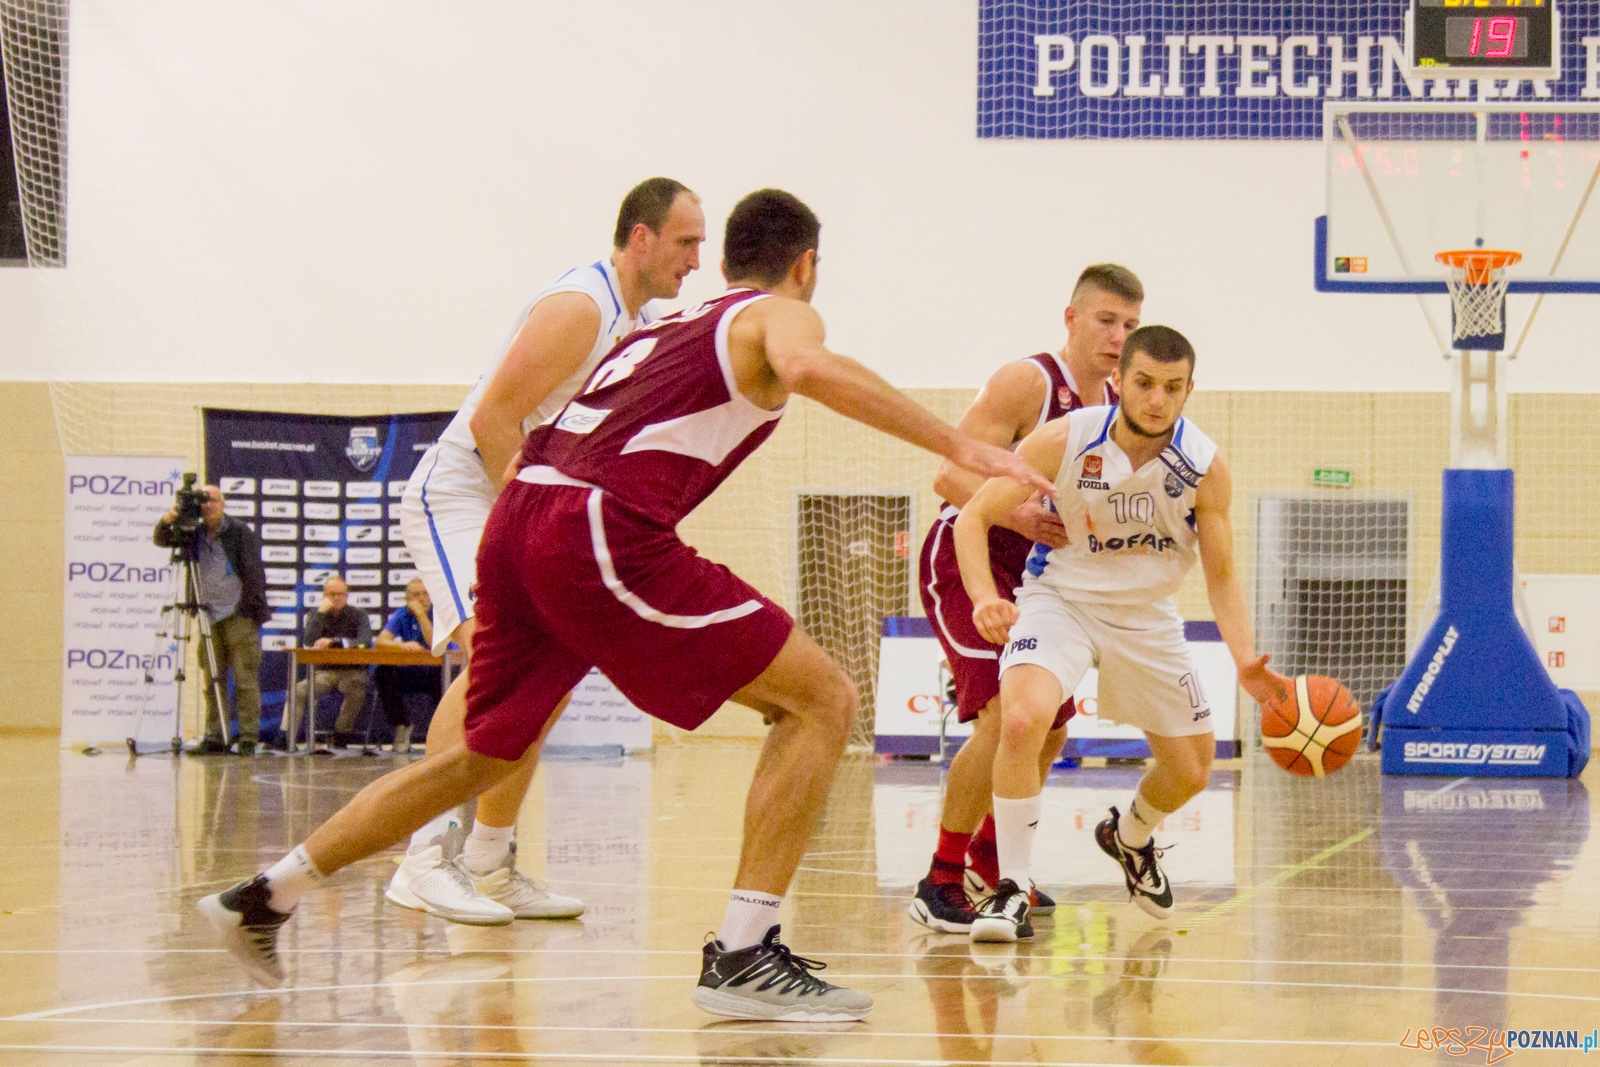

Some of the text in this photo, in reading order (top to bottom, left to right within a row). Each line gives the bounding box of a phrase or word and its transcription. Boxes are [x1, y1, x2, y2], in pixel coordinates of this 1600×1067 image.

[1469, 16, 1518, 58] 19
[1033, 35, 1552, 98] POLITECHN
[1108, 492, 1155, 527] 10
[1011, 637, 1038, 654] PBG
[1406, 625, 1459, 714] HYDROPLAY
